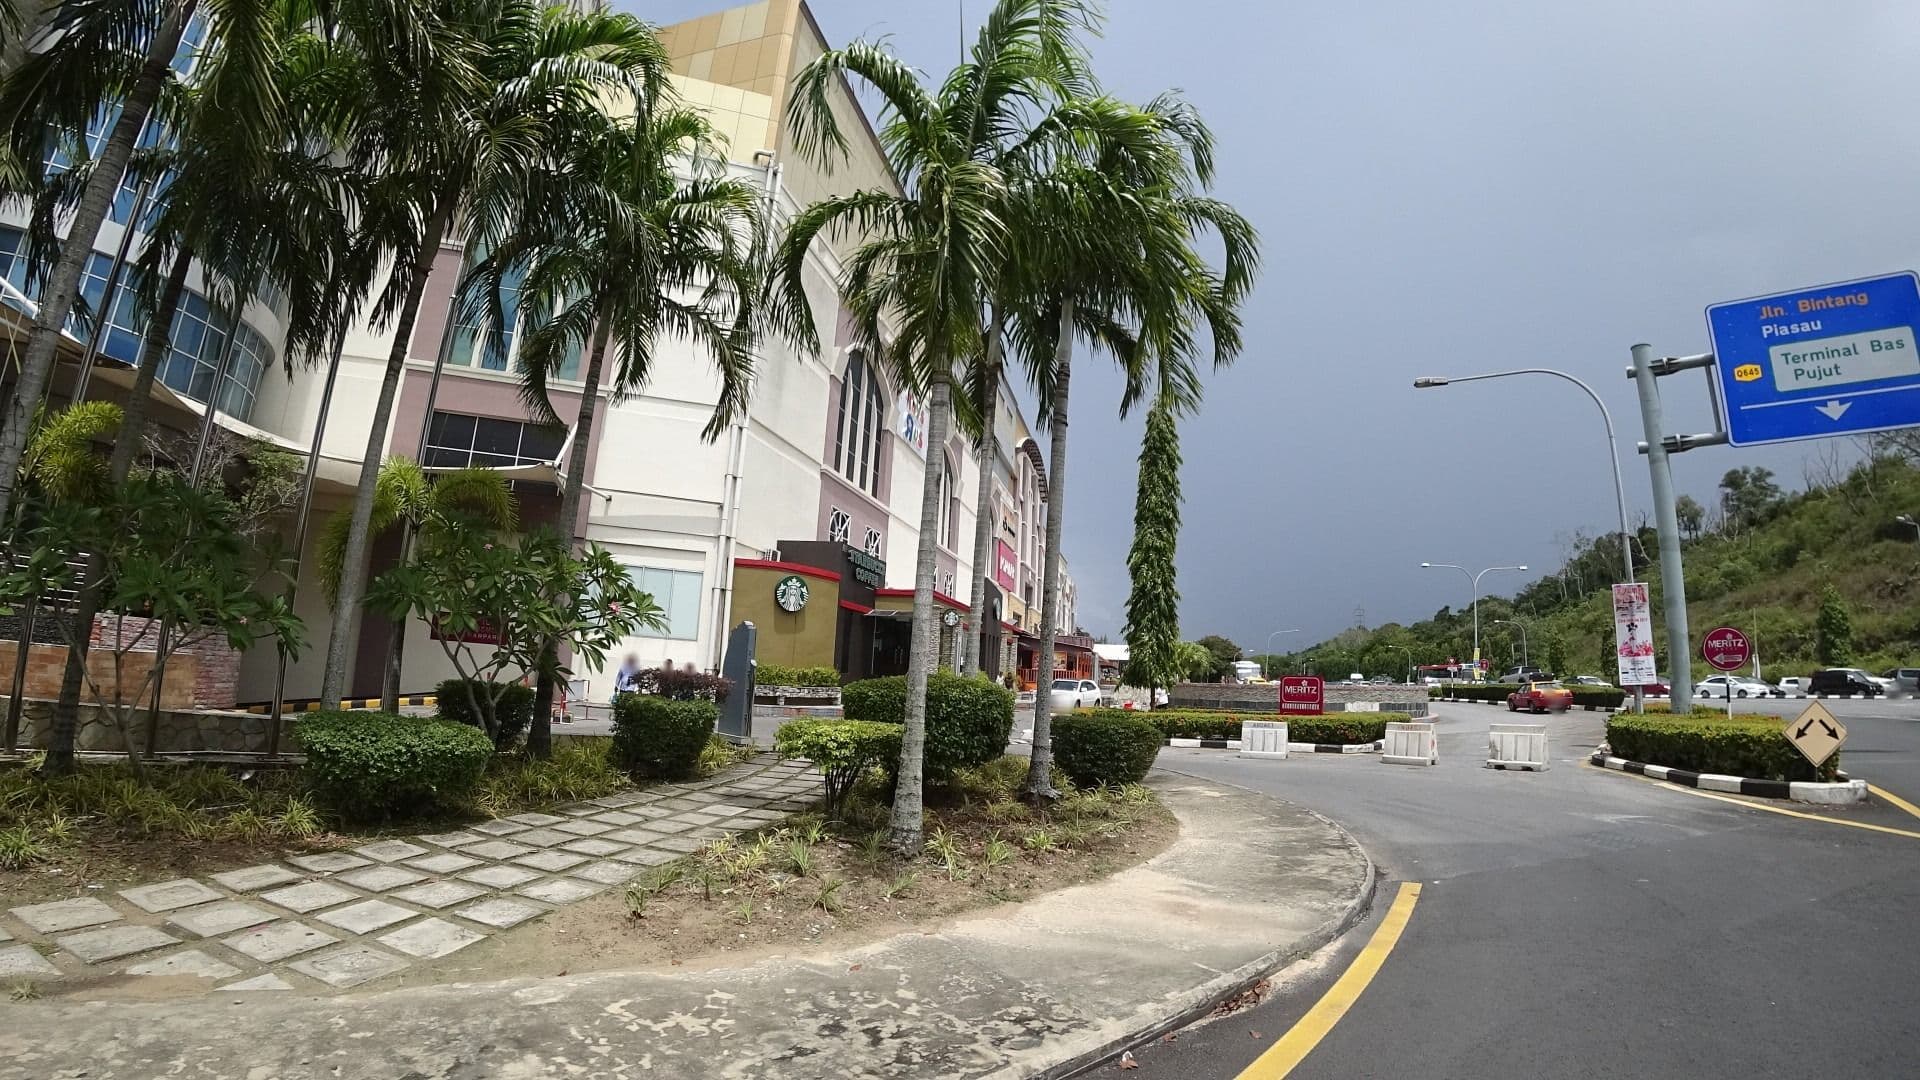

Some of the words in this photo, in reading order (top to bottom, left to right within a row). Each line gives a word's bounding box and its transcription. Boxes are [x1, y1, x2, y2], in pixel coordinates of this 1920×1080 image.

[1759, 306, 1788, 320] Jln.
[1797, 292, 1869, 313] Bintang
[1761, 319, 1823, 338] Piasau
[1781, 343, 1859, 366] Terminal
[1870, 338, 1905, 353] Bas
[1794, 363, 1842, 381] Pujut
[1708, 638, 1744, 648] MERITZ
[1284, 685, 1317, 694] MERITZ
